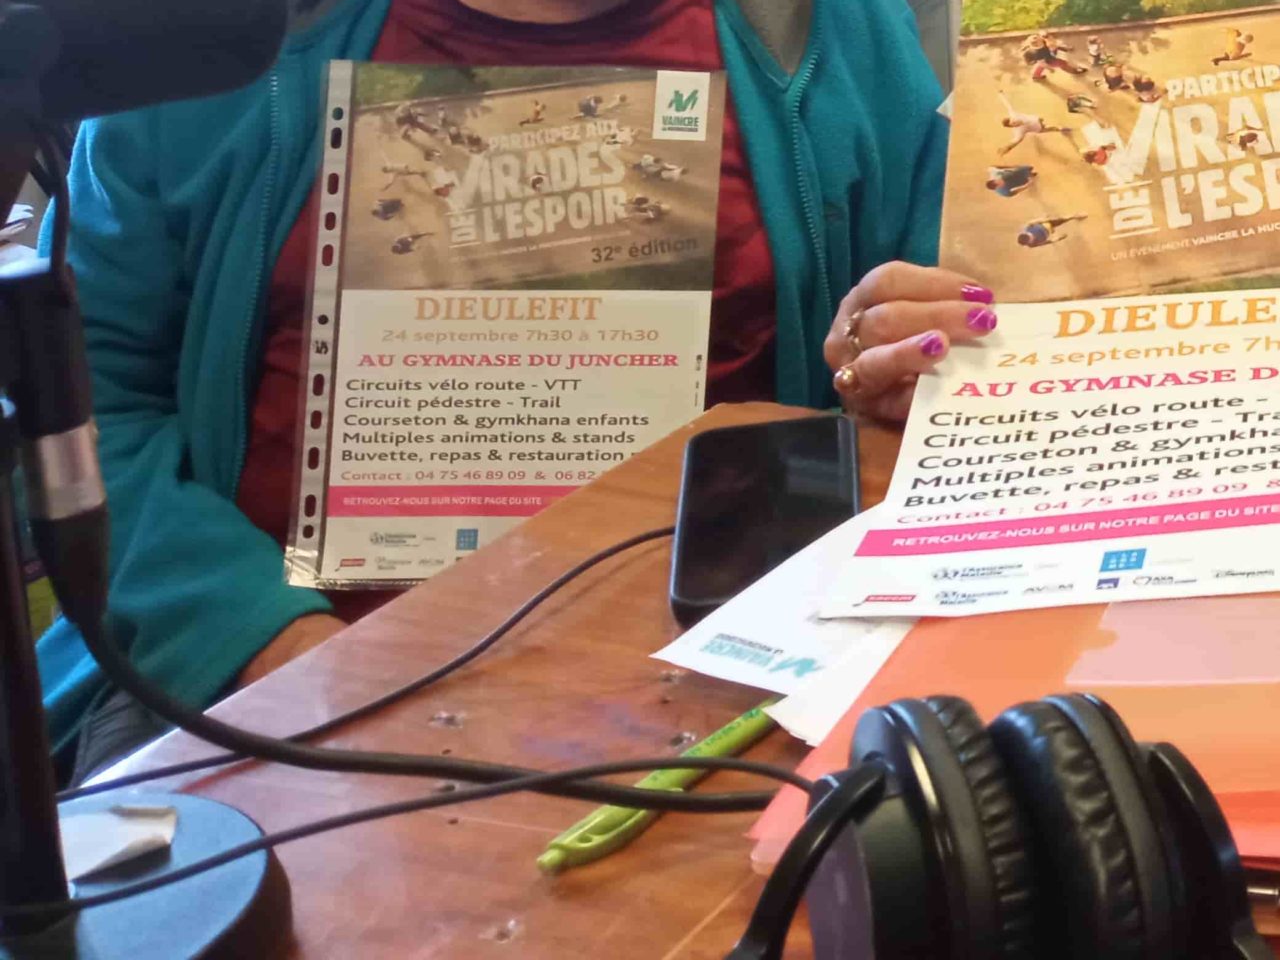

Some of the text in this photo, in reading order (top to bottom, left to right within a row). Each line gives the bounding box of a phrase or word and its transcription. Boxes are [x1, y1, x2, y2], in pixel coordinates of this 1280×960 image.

[662, 115, 700, 128] VAINCRE
[480, 188, 629, 241] L'ESPOIR
[629, 237, 698, 258] édition
[1192, 230, 1239, 246] VAINCRE
[415, 297, 602, 320] DIEULEFIT
[382, 329, 659, 346] 24 septembre 7h30 17h30
[358, 354, 679, 369] AU GYMNASE DU JUNCHER
[998, 352, 1040, 367] 24
[1051, 340, 1230, 365] septembre
[346, 378, 581, 391] Circuits vélo route VTT
[953, 382, 1016, 397] AU
[1030, 369, 1237, 395] GYMNASE
[345, 396, 560, 413] Circuit pédestre Trail
[929, 409, 1058, 427] Circuits
[1071, 402, 1141, 419] vélo
[1152, 396, 1244, 413] route
[344, 414, 649, 428] Courseton gymkhana enfants
[343, 431, 635, 447] Multiples animations stands
[923, 430, 1038, 448] Circuit
[1049, 417, 1199, 443] pédestre
[342, 450, 624, 464] Buvette, repas restauration
[917, 444, 1097, 470] Courseton
[341, 470, 573, 481] Contact 06
[911, 463, 1073, 490] Multiples
[904, 482, 1050, 508] Buvette,
[1064, 471, 1158, 494] repas
[896, 506, 1006, 524] Contact
[1034, 502, 1067, 512] 04
[1080, 496, 1113, 507] 75
[1167, 487, 1202, 498] 89
[892, 525, 1054, 546] RETROUVEZ-NOUS
[1059, 522, 1095, 533] SUR
[1100, 516, 1158, 530] NOTRE
[1163, 510, 1210, 522] PAGE
[1215, 506, 1240, 518] DU
[1244, 503, 1280, 515] SITE
